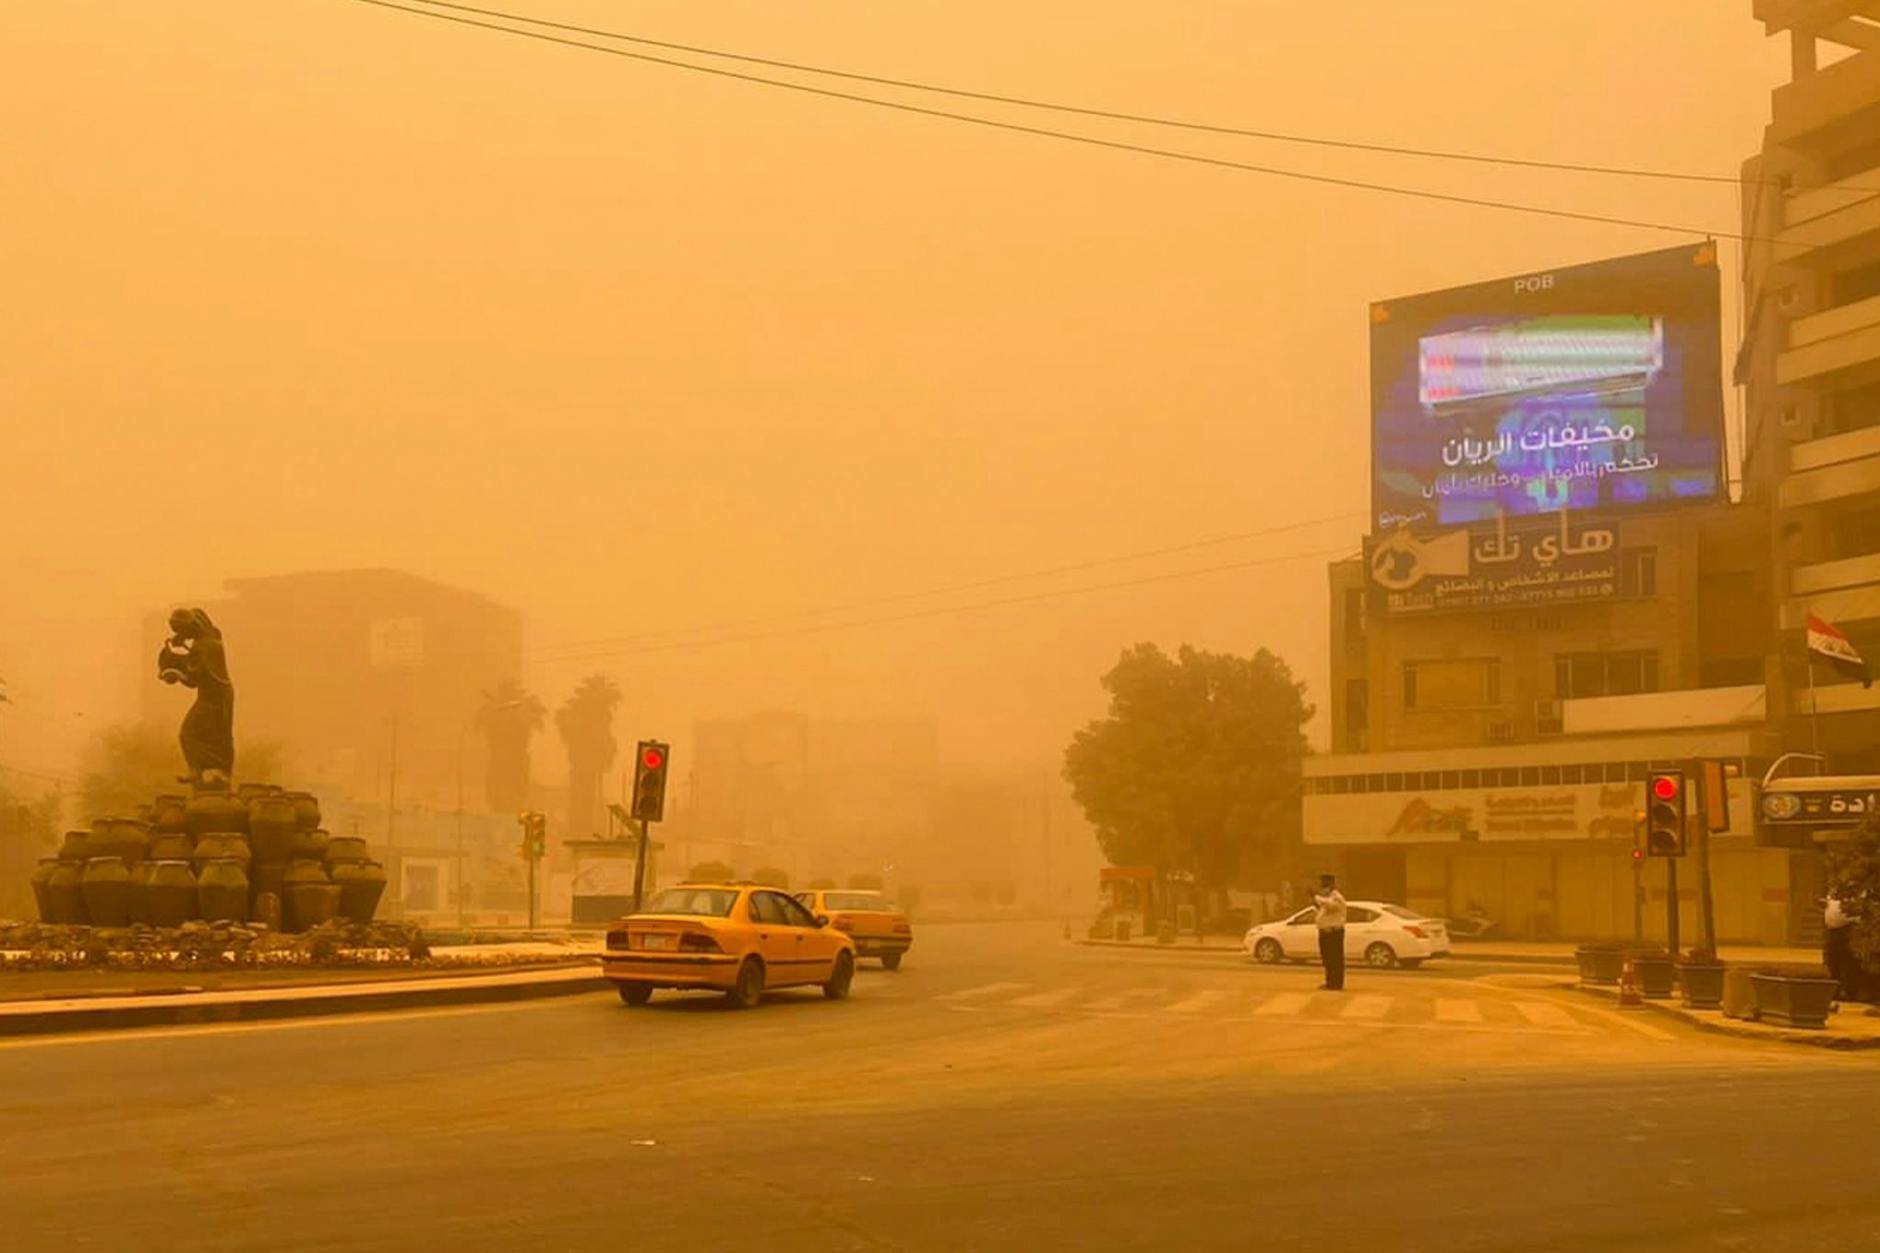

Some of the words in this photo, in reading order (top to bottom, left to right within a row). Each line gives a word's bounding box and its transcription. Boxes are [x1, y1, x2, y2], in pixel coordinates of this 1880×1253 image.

[1514, 274, 1554, 294] POB
[1442, 430, 1512, 466] الريان
[1473, 509, 1520, 563] تك
[1532, 507, 1614, 567] هاي
